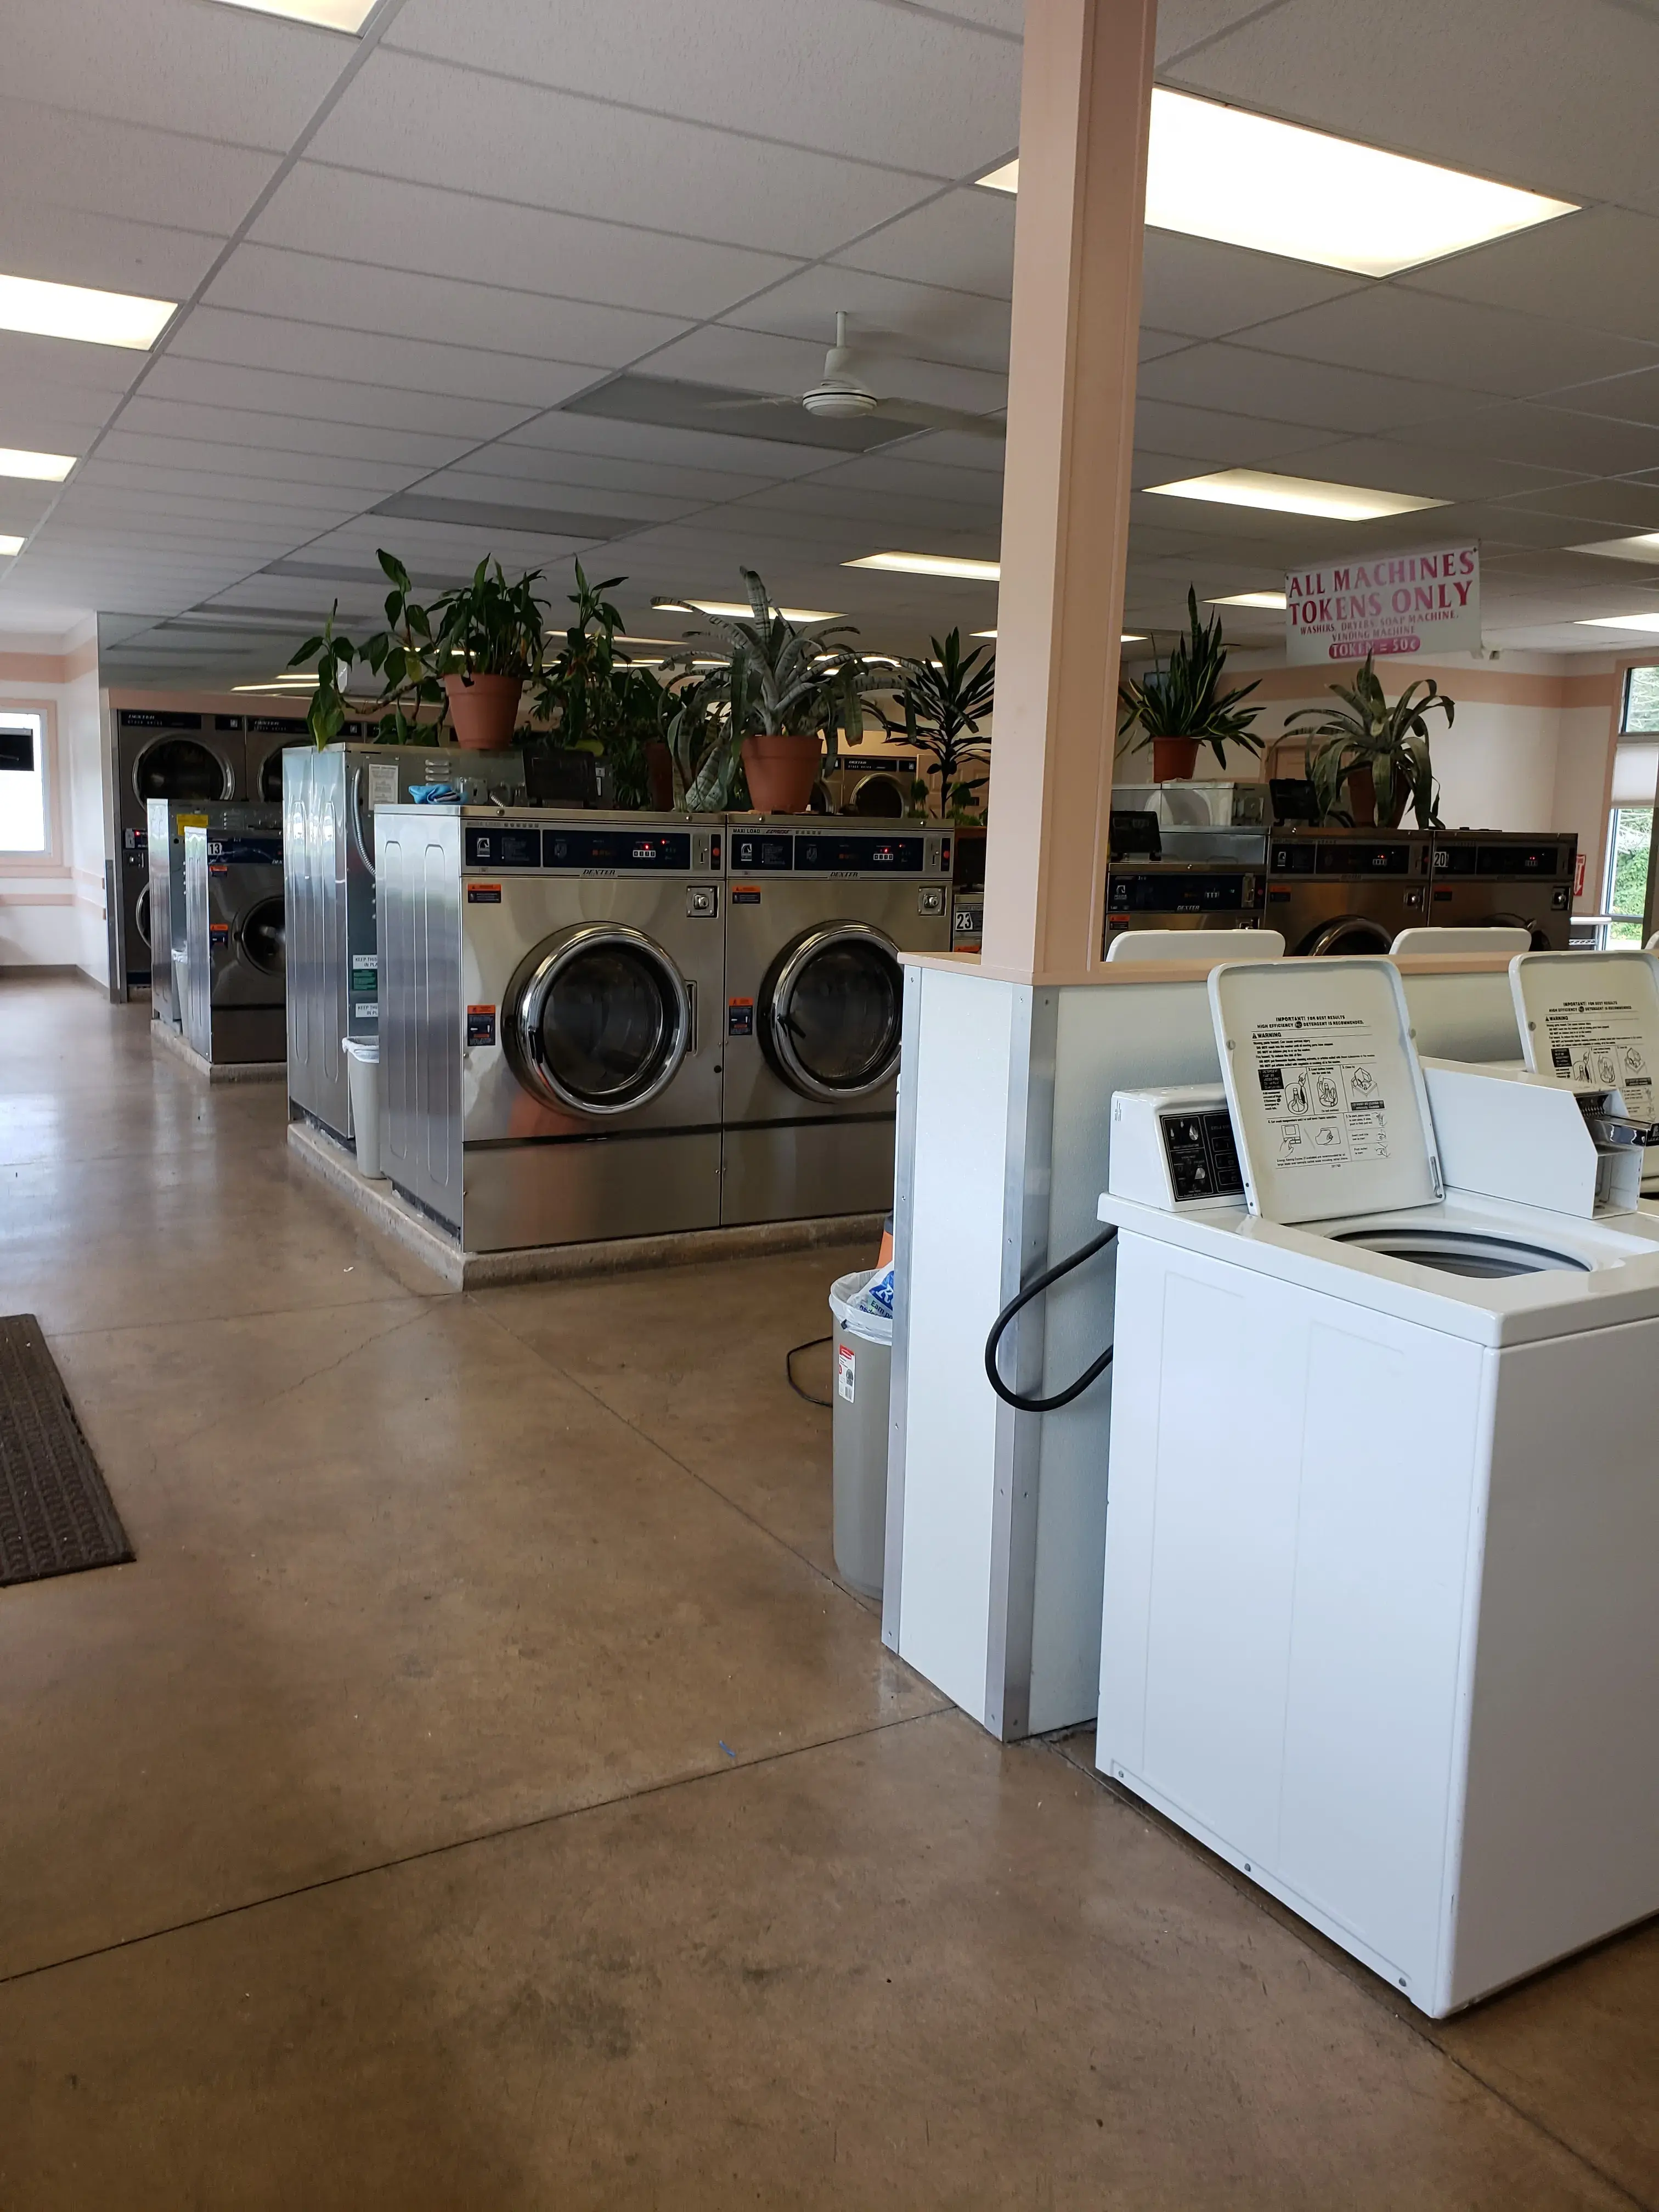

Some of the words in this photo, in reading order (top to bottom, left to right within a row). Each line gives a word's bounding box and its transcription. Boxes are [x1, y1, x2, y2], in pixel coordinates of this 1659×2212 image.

[1289, 573, 1325, 598] ALL
[1334, 550, 1475, 592] MACHINES
[1289, 592, 1382, 625] TOKENS
[1392, 580, 1472, 614] ONLY
[1380, 616, 1405, 626] SOAP
[1332, 630, 1370, 642] VENDING
[1373, 625, 1415, 639] MACHINE
[1332, 642, 1375, 657] TOKEN
[210, 844, 220, 854] 13
[1434, 853, 1446, 866] 20
[956, 913, 972, 929] 23
[871, 1300, 884, 1314] Earn
